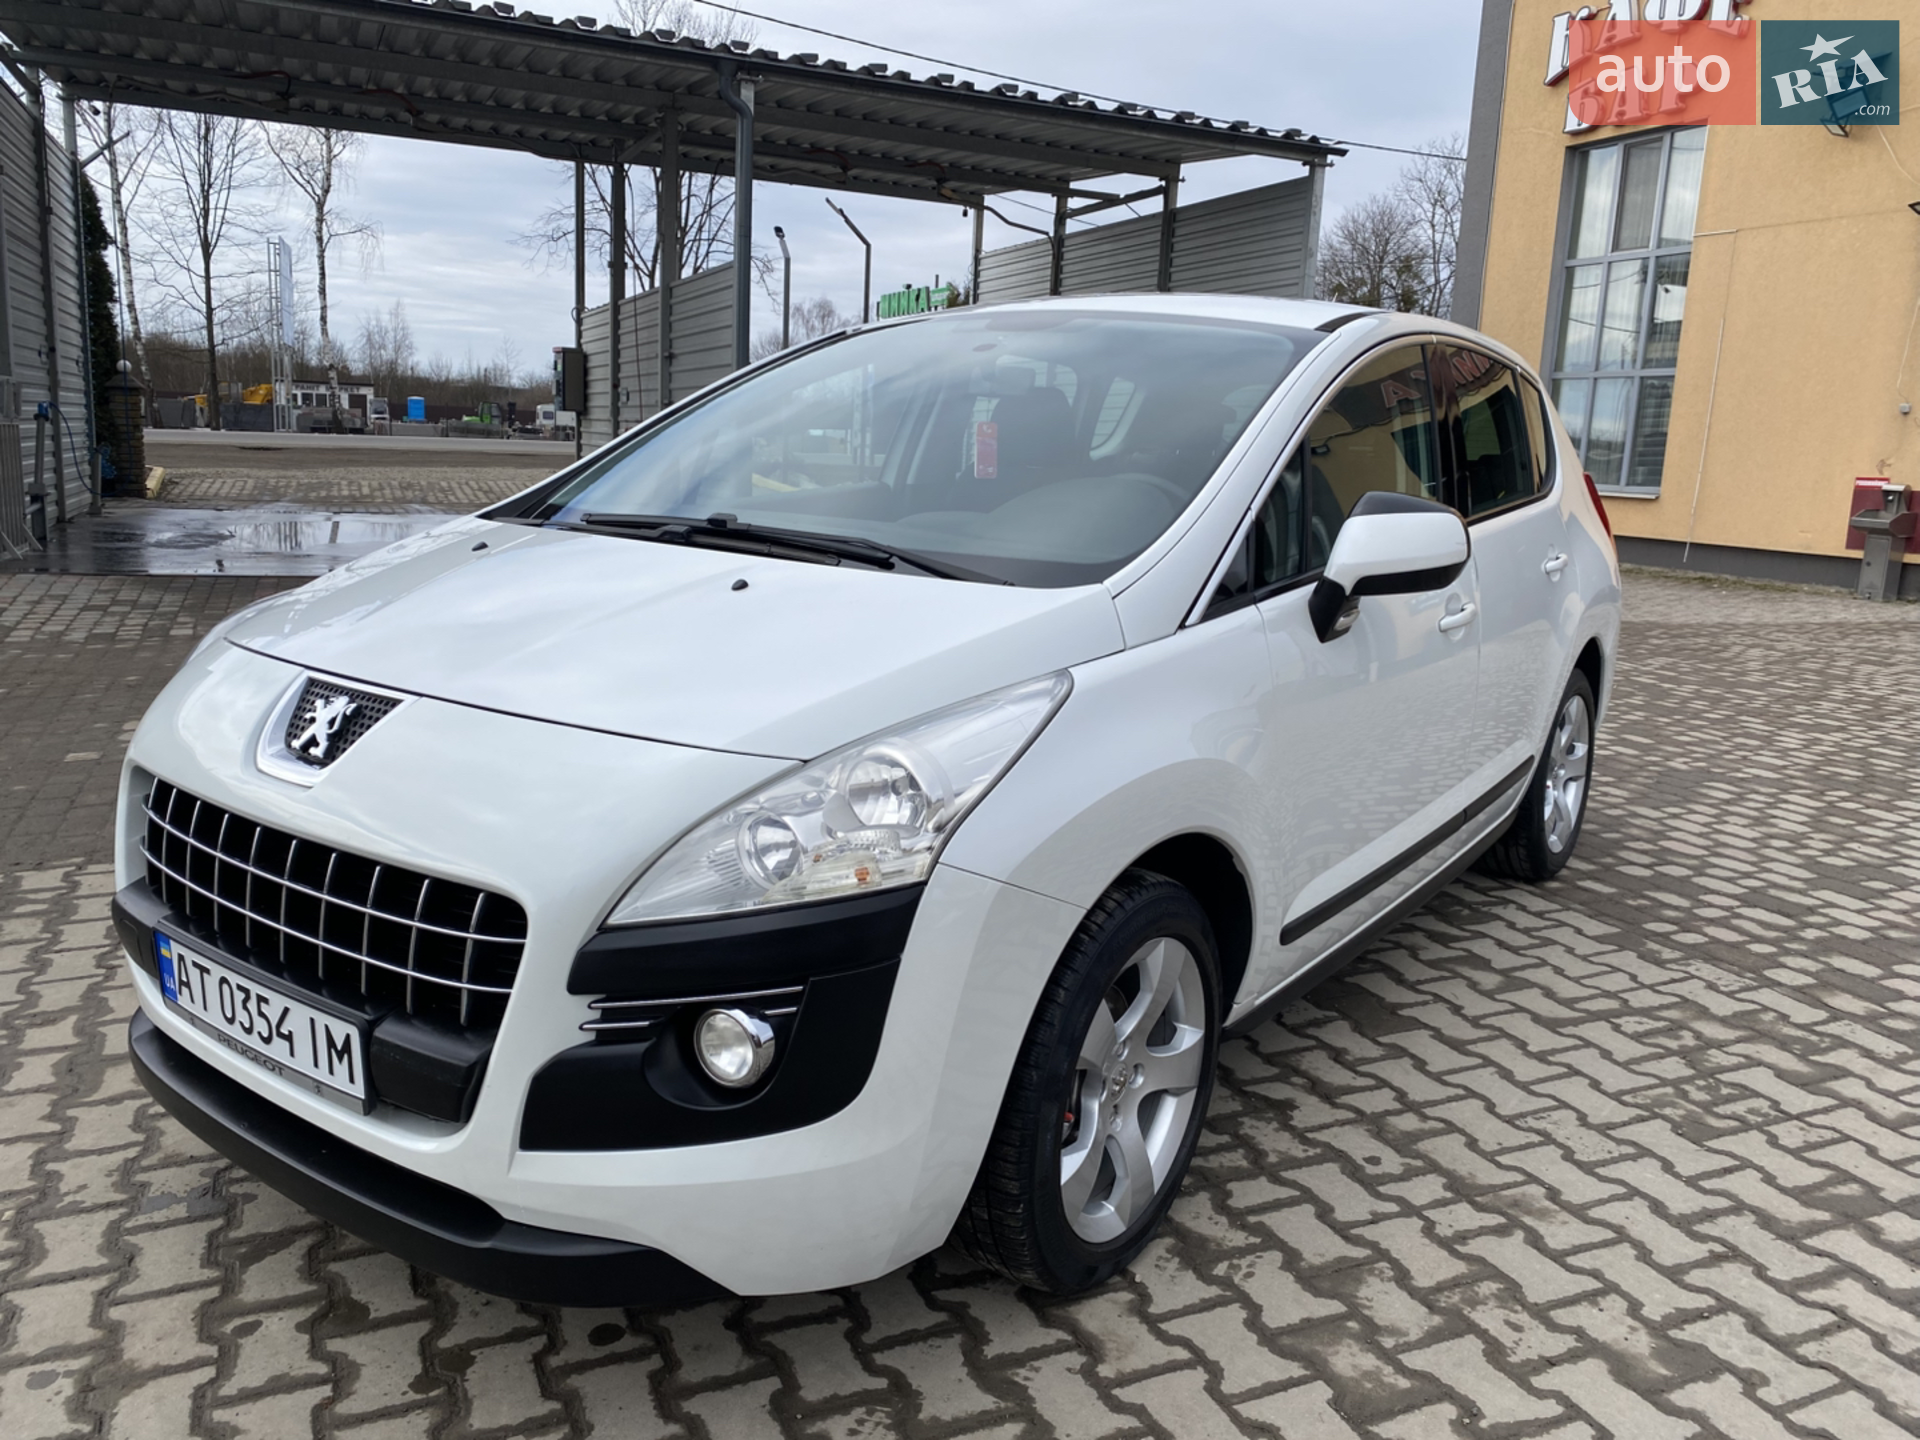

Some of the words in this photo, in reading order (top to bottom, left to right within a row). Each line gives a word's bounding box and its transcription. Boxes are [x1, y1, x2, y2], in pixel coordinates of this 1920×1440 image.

[177, 952, 211, 1012] AT
[218, 975, 295, 1058] 0354
[309, 1016, 355, 1085] IM
[217, 1033, 285, 1077] PEUGEOT
